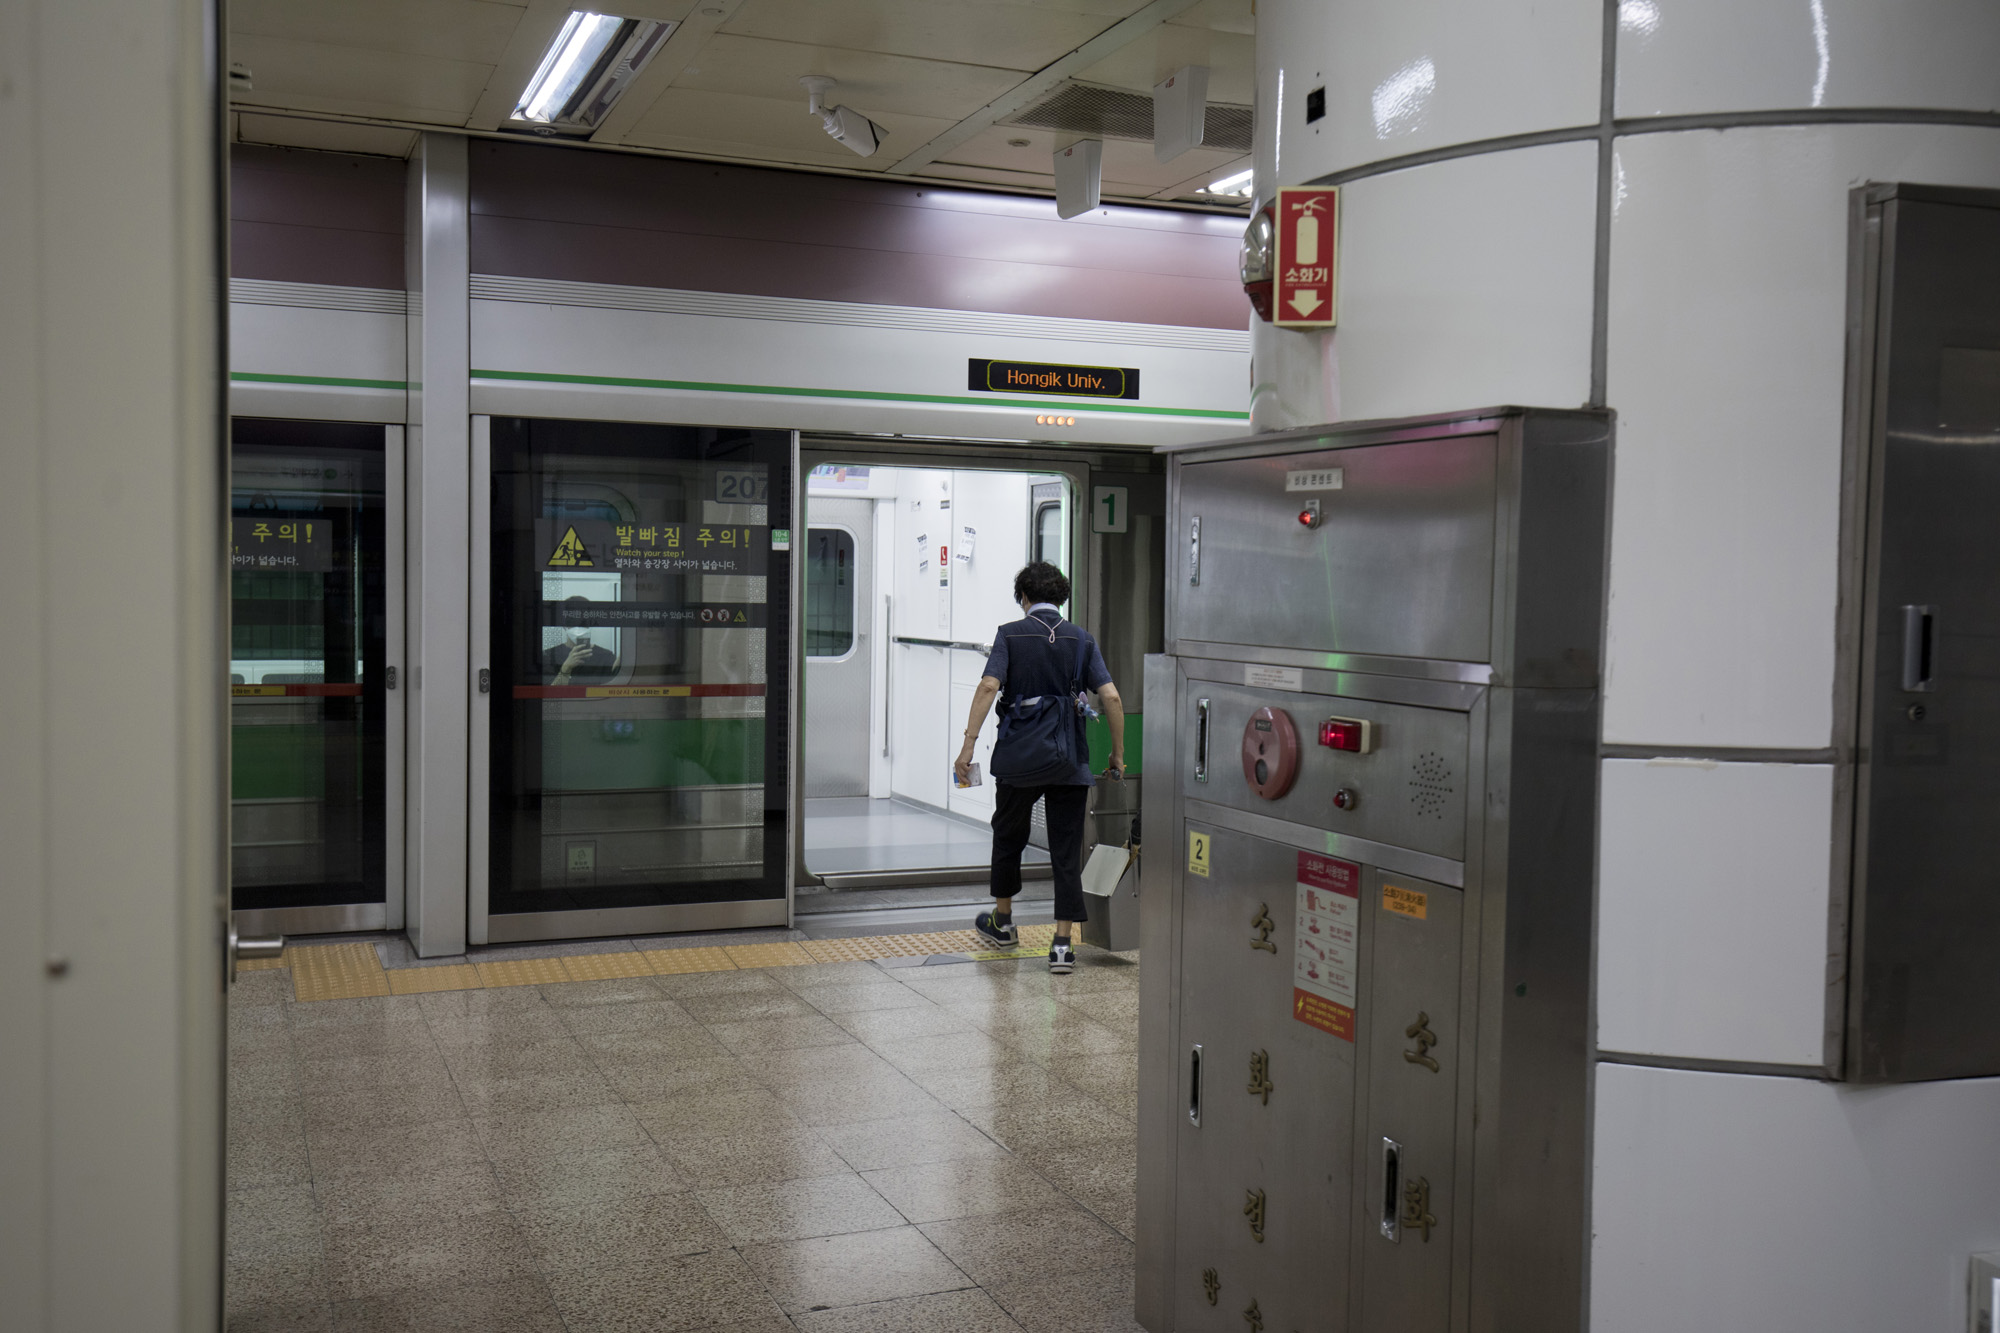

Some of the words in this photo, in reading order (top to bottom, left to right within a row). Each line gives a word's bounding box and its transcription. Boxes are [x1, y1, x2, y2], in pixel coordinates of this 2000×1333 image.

[1285, 268, 1328, 283] 소화기
[1007, 369, 1062, 387] Hongik
[1067, 373, 1106, 389] Univ.
[1101, 493, 1115, 526] 1
[252, 523, 313, 544] 주의!
[616, 525, 680, 547] 발빠짐
[696, 528, 750, 548] 주의!
[616, 548, 641, 556] Watch
[614, 558, 641, 569] 열차와
[643, 558, 670, 569] 승강장
[673, 559, 699, 569] 사이가
[1195, 838, 1203, 860] 2
